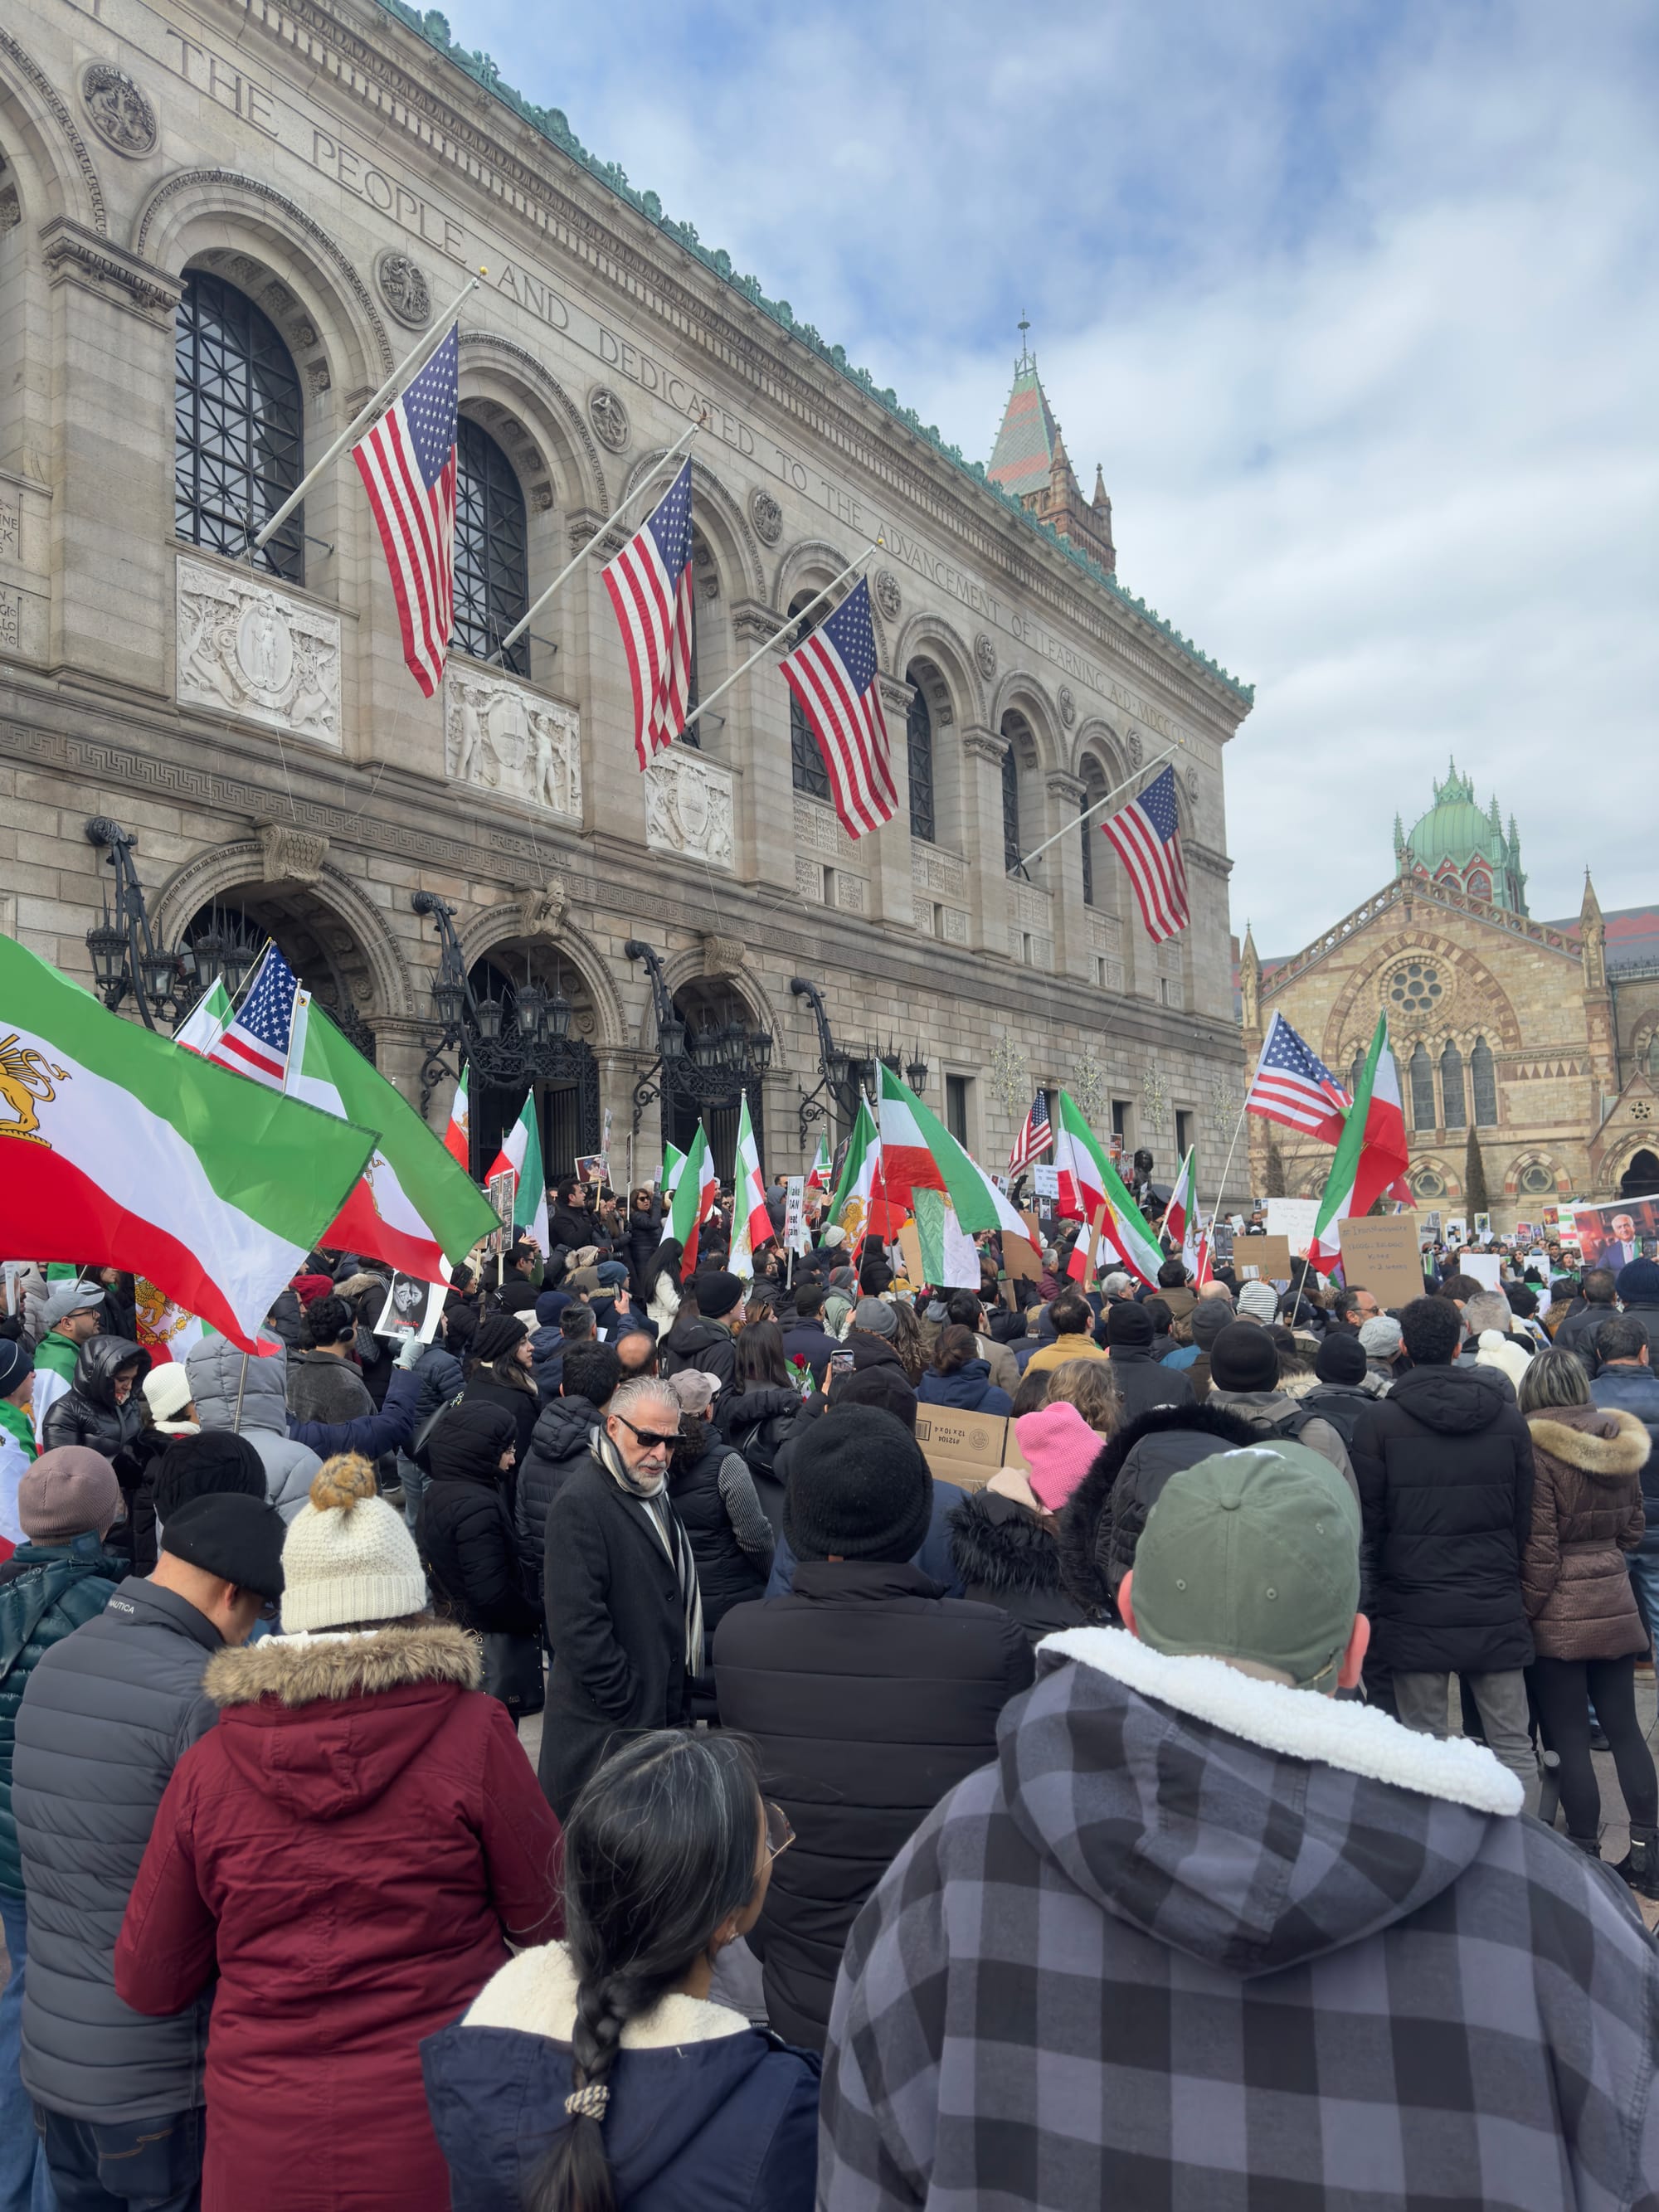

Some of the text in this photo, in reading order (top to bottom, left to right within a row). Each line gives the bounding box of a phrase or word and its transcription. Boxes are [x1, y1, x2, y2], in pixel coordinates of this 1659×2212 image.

[166, 28, 280, 138] THE
[313, 129, 467, 265] PEOPLE
[498, 264, 569, 330] AND
[599, 328, 754, 455] DEDICATED
[776, 450, 807, 491] TO
[821, 481, 864, 532] THE
[876, 523, 1000, 620] ADVANCEMENT
[1011, 615, 1031, 642] OF
[1041, 633, 1105, 693] LEARNING
